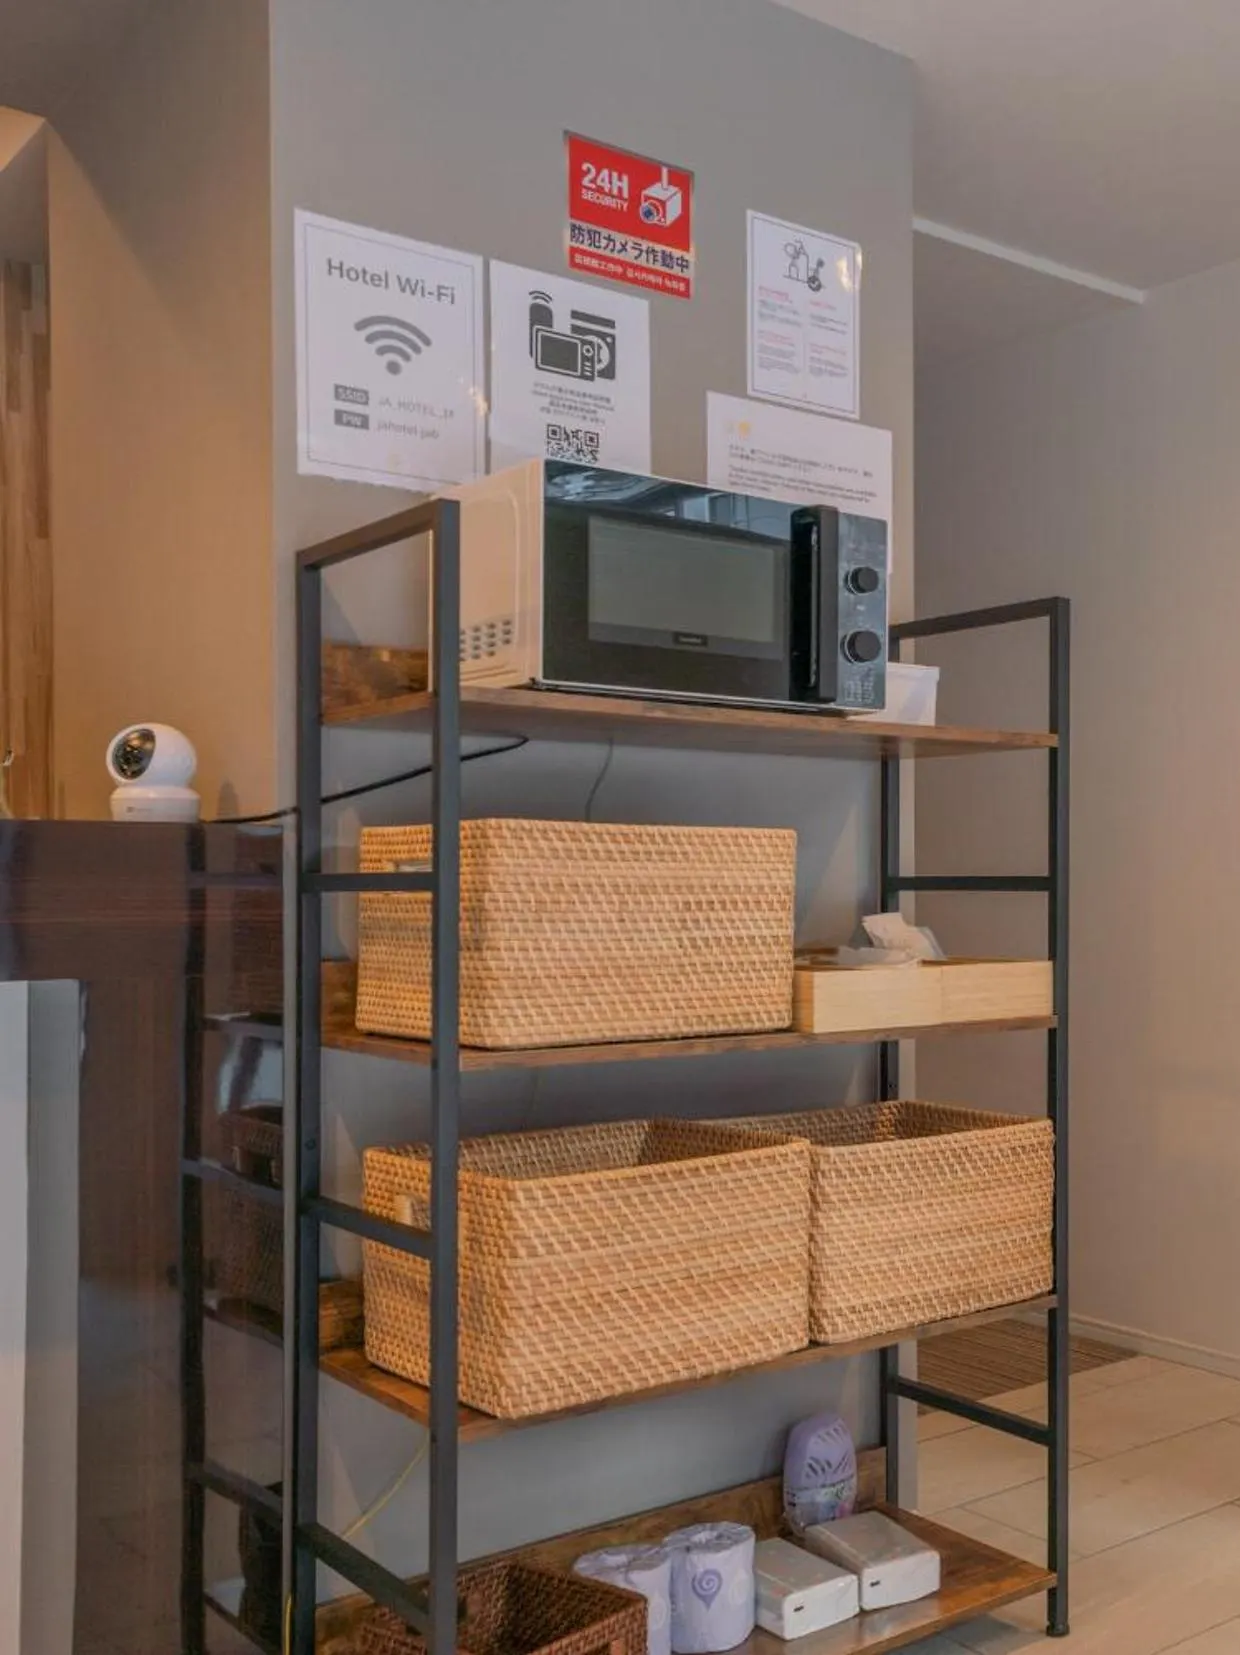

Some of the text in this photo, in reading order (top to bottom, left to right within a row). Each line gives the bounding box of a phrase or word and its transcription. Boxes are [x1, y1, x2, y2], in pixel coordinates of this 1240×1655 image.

[581, 161, 629, 199] 24H
[581, 188, 629, 212] SECURITY
[570, 222, 690, 273] 防犯カメラ作動中
[327, 257, 455, 305] Hotel Wi-Fi
